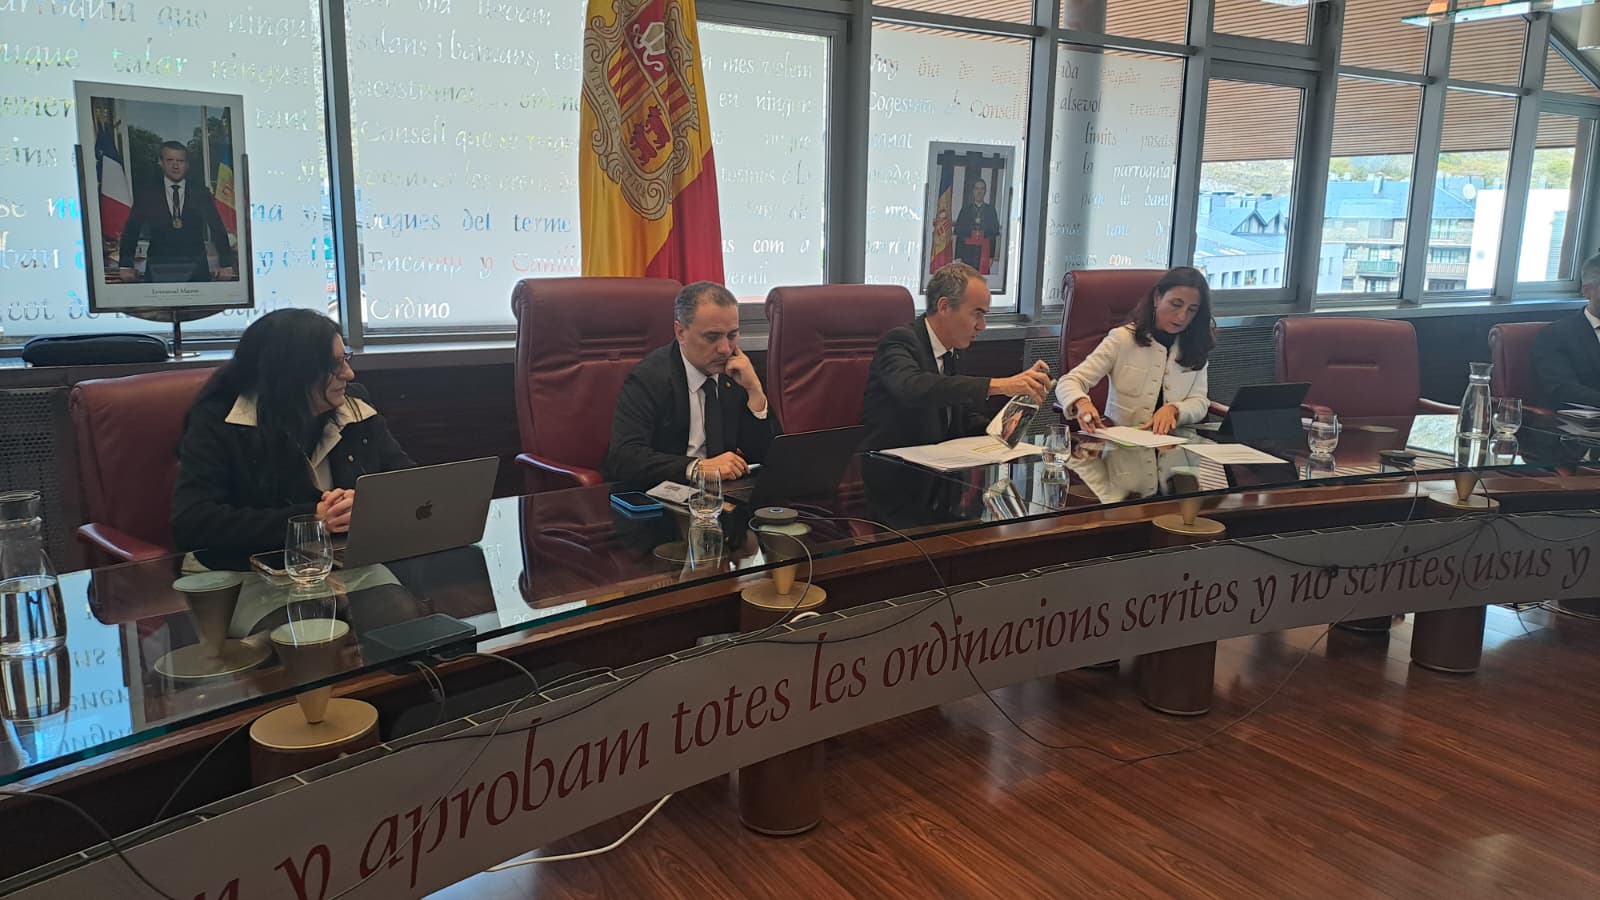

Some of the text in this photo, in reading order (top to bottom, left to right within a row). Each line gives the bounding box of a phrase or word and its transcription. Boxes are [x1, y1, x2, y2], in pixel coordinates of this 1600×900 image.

[752, 239, 785, 255] com
[1108, 253, 1133, 266] com
[370, 296, 451, 321] Ordino
[359, 717, 650, 889] aprobam
[671, 676, 791, 755] totes
[808, 630, 867, 712] les
[882, 597, 1111, 688] ordinacions
[1120, 572, 1239, 633] scrites
[1249, 574, 1277, 625] y
[1290, 565, 1334, 604] no
[1473, 546, 1553, 583] usus
[1561, 545, 1591, 590] y
